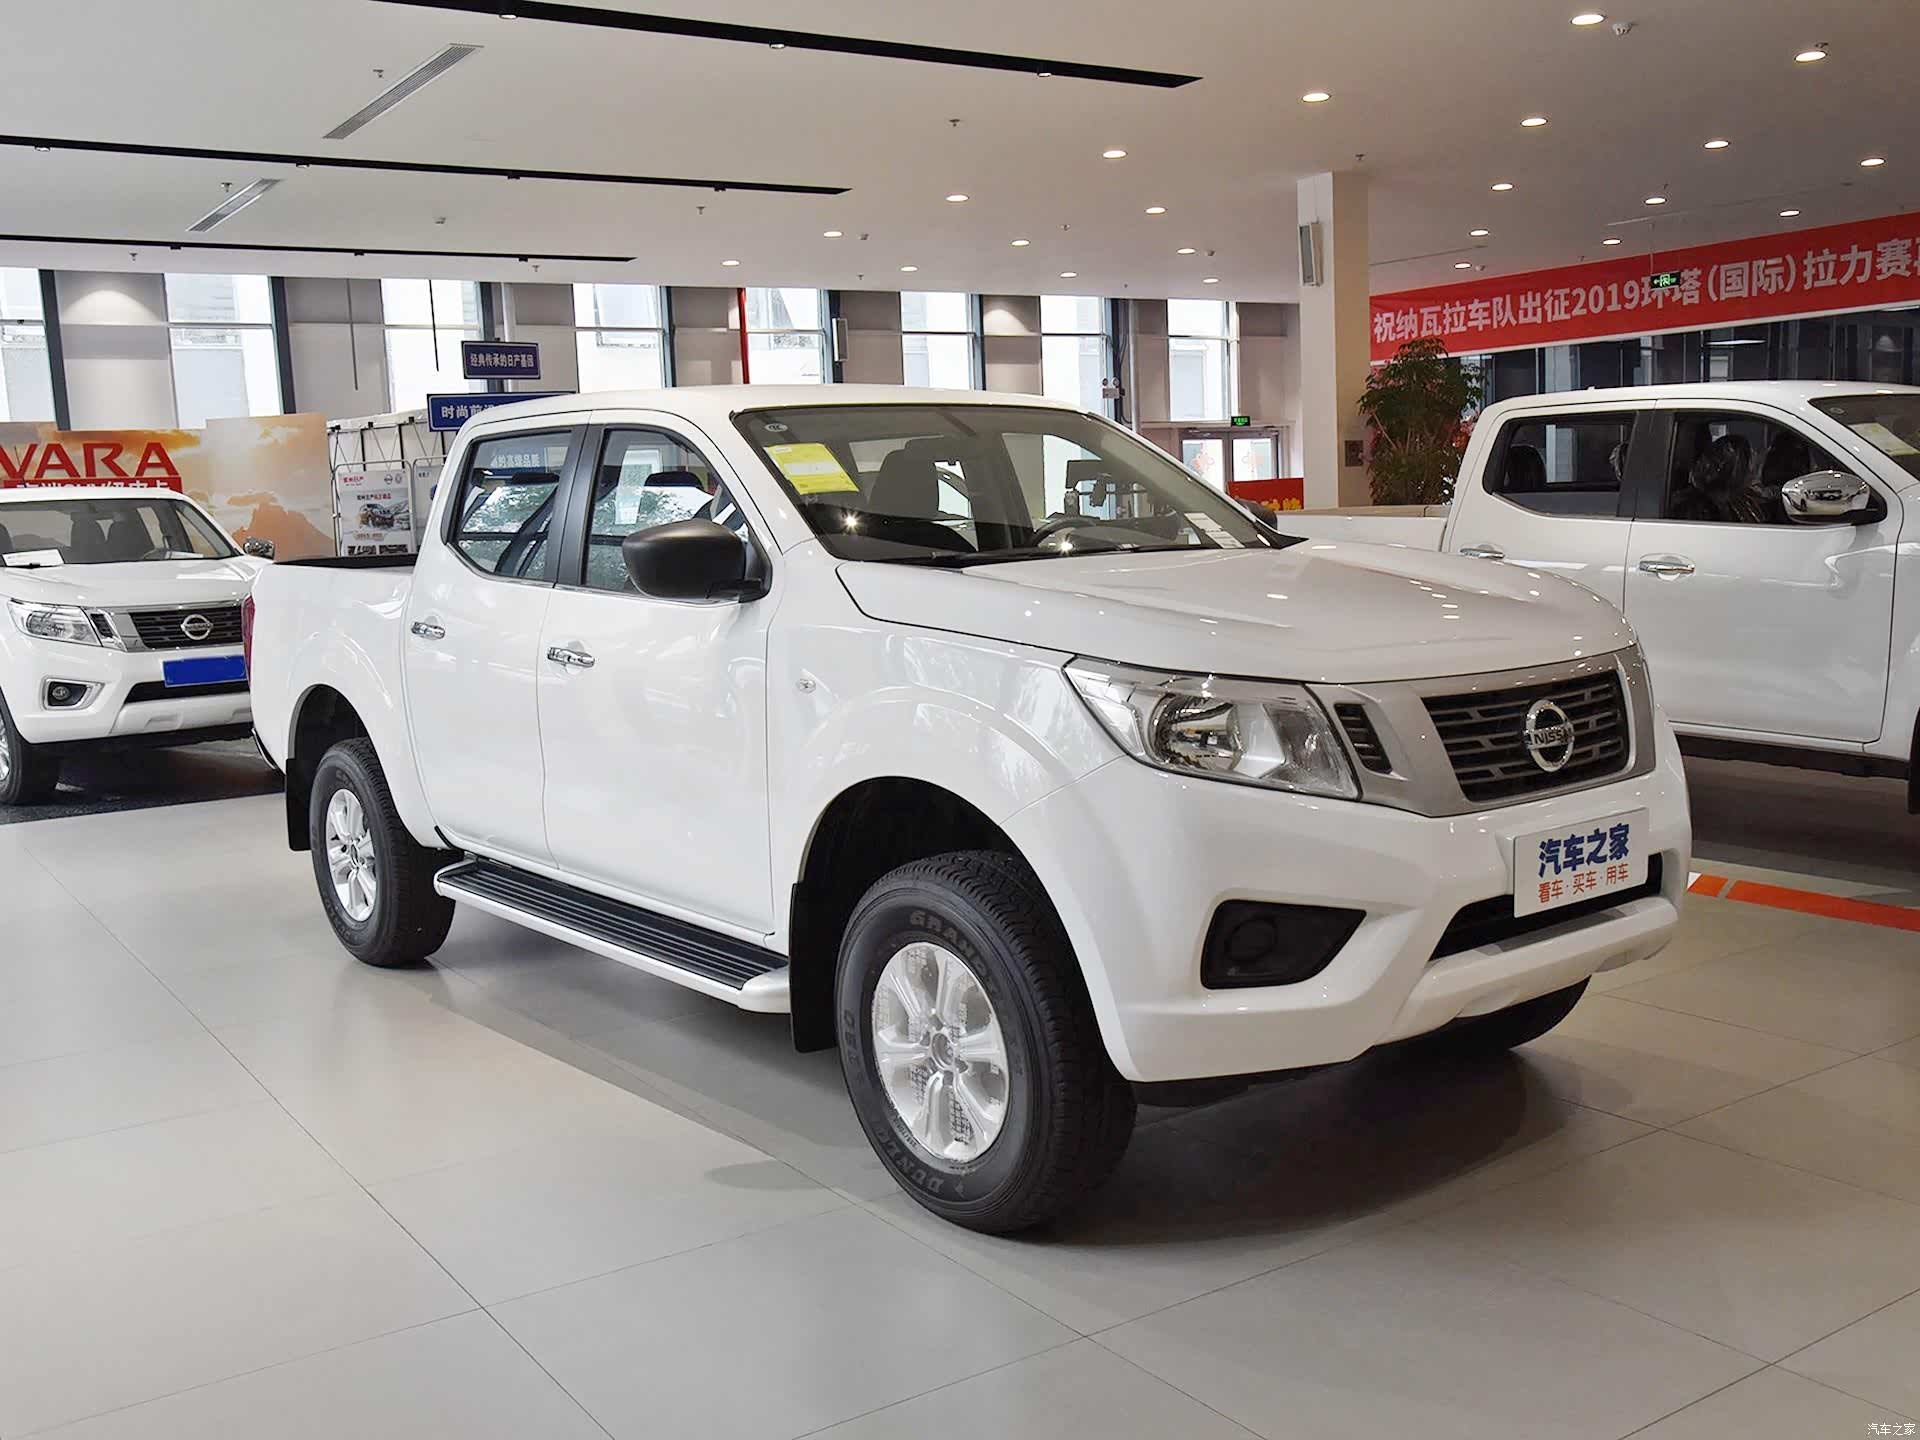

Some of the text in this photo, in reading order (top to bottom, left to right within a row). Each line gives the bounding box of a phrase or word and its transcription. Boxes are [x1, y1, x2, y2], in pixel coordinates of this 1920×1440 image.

[1374, 236, 1920, 342] 祝纳瓦拉车队出征2019环塔(国际)拉力赛
[1538, 822, 1630, 878] 汽车之家
